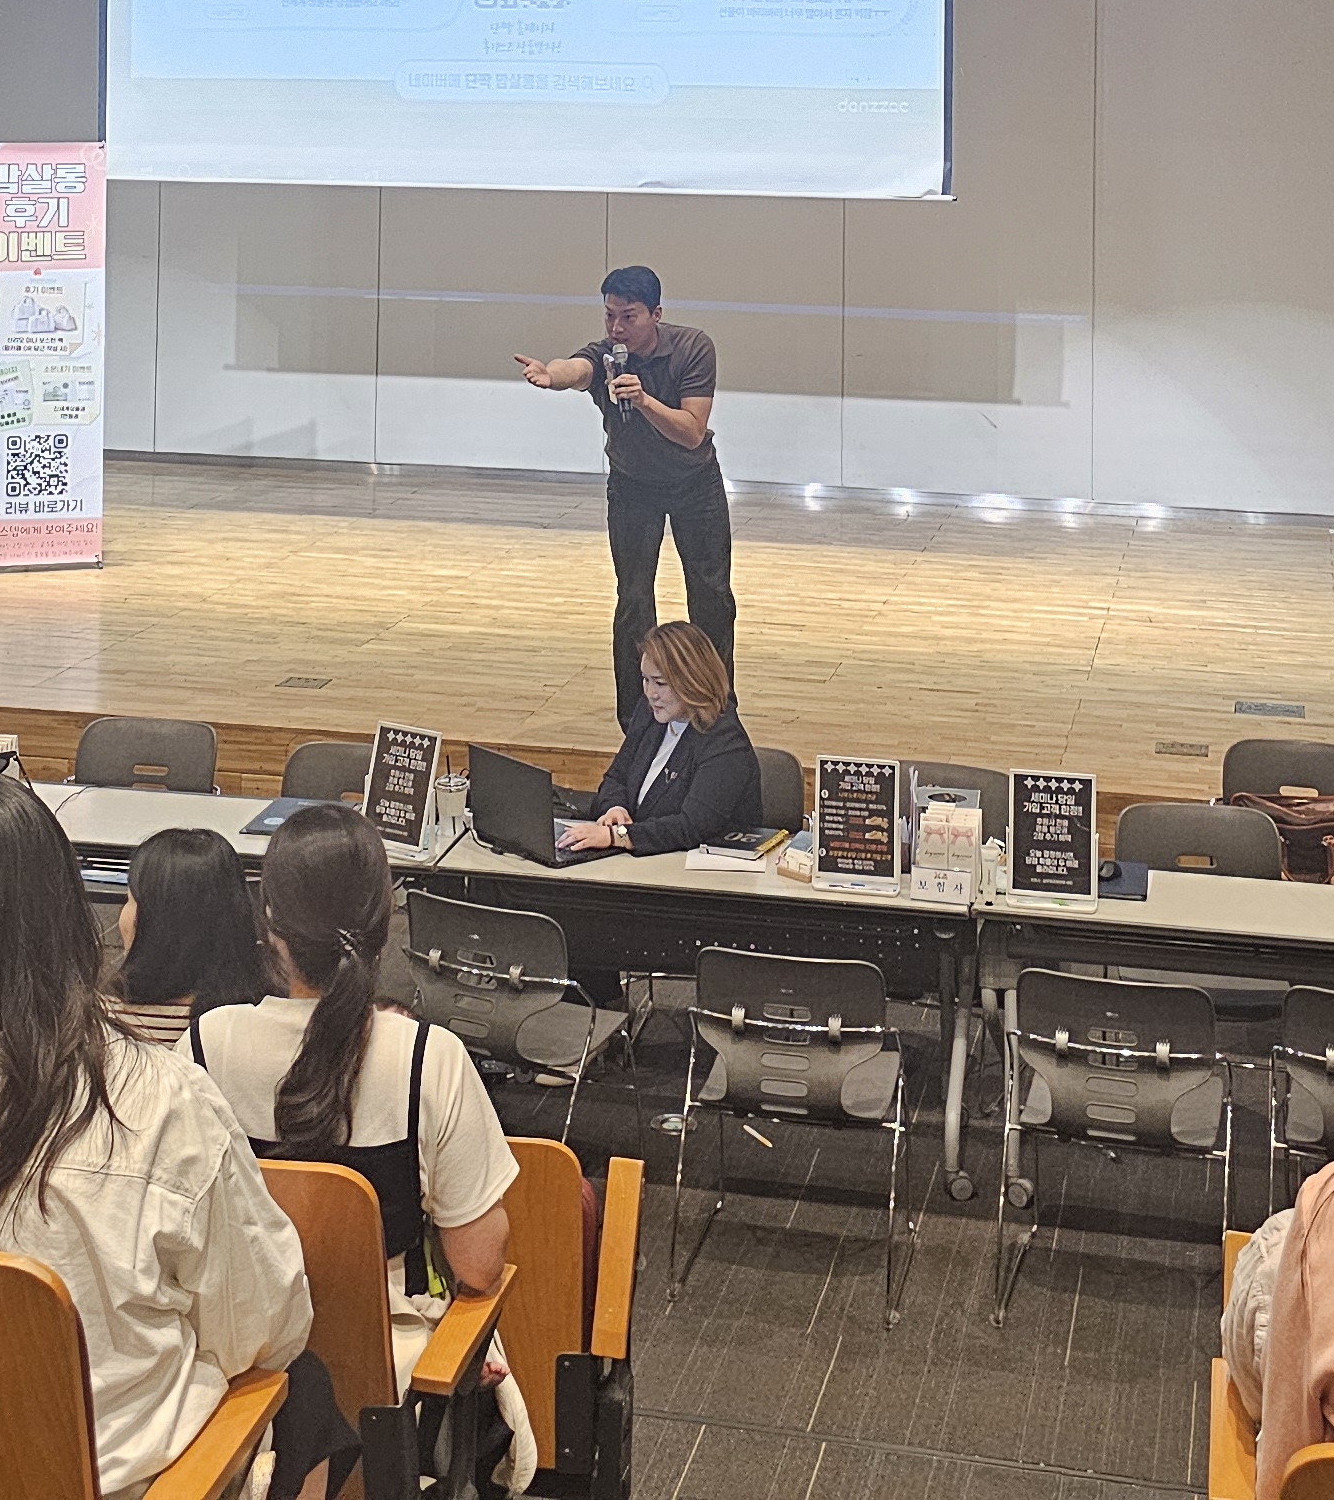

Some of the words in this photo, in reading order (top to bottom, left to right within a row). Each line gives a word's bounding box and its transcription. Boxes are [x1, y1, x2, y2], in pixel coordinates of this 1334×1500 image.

[3, 197, 70, 229] 후기
[5, 501, 30, 515] 리뷰
[33, 498, 83, 514] 바로가기
[1030, 792, 1057, 804] 세미나
[1058, 794, 1076, 806] 당일
[1022, 801, 1040, 813] 가입
[1041, 803, 1060, 815] 고객
